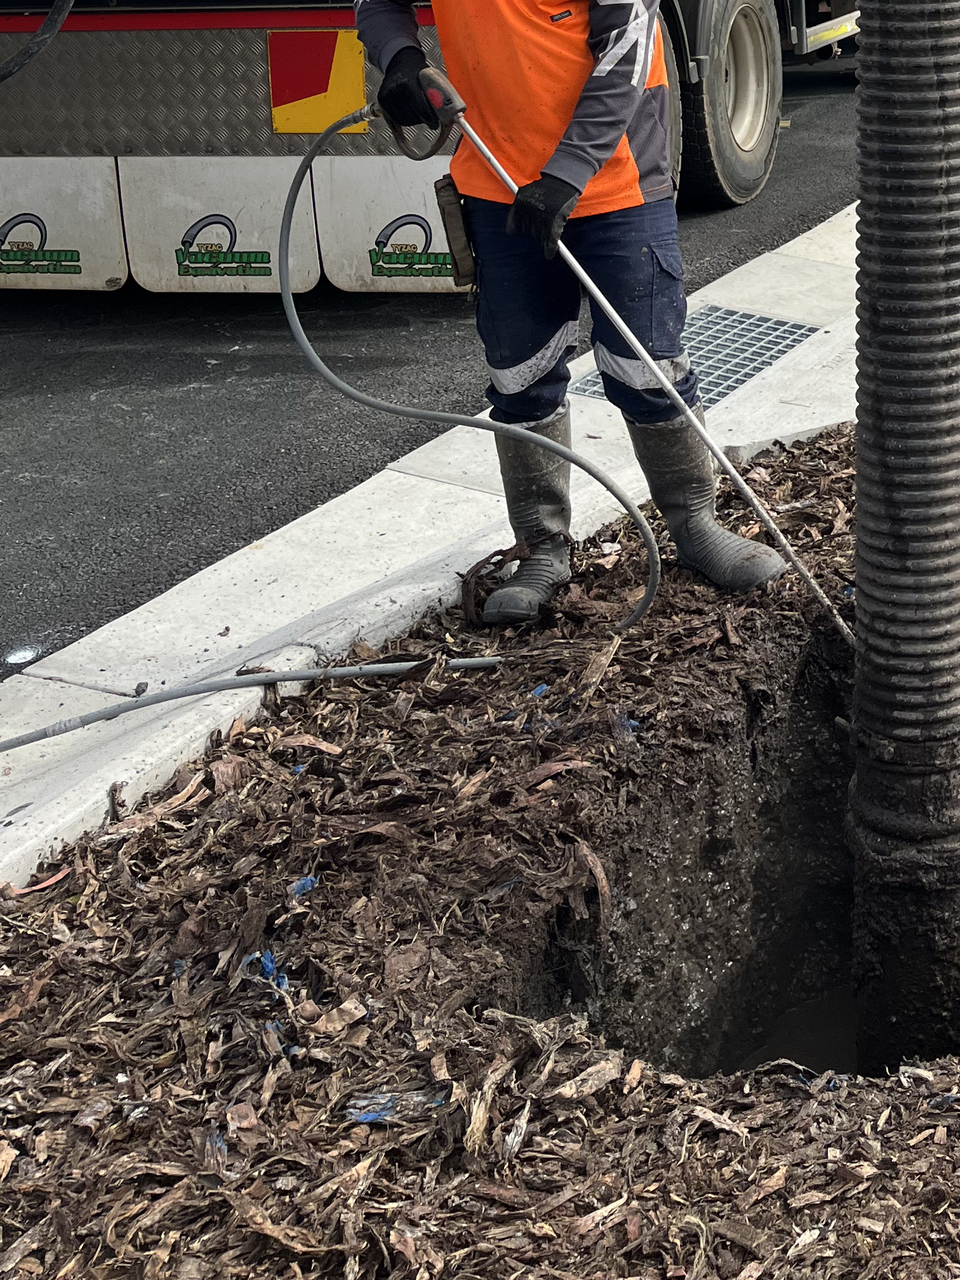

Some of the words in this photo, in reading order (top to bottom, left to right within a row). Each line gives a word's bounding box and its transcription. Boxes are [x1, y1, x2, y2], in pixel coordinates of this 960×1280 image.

[196, 243, 223, 252] TYZAC
[390, 243, 418, 252] TYZAC
[0, 249, 80, 262] acuum
[175, 246, 271, 265] Vacuum
